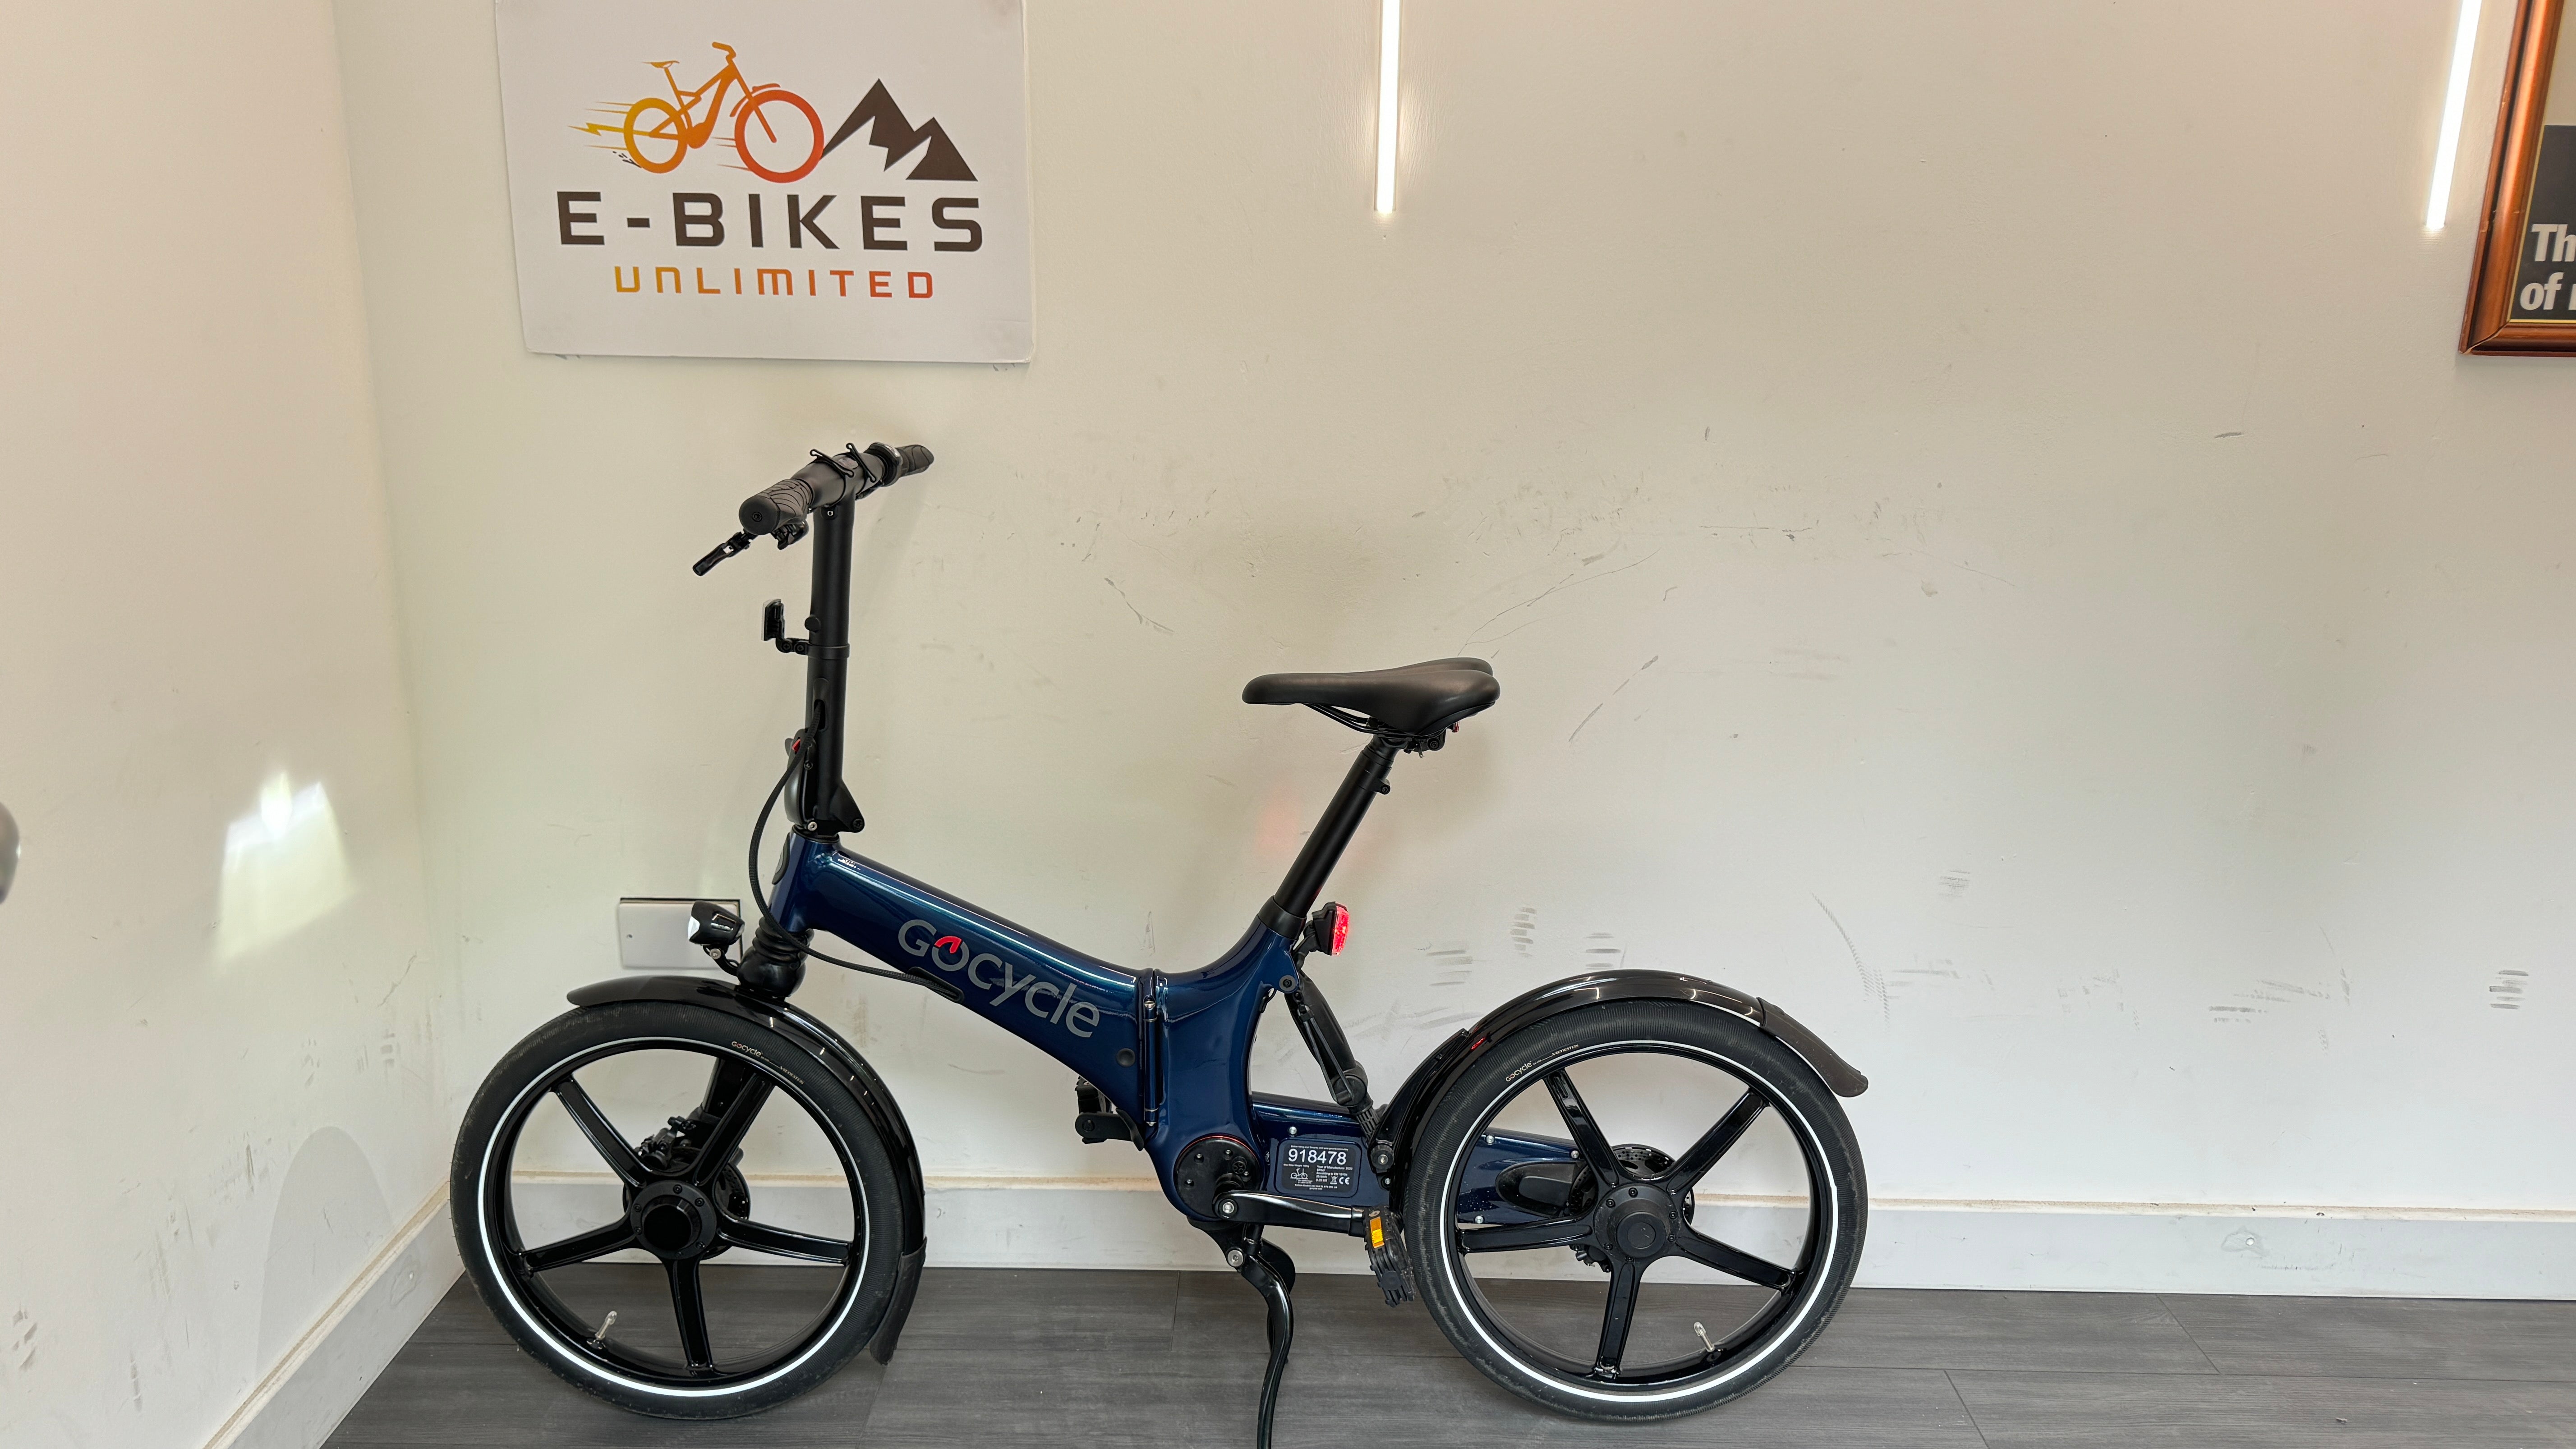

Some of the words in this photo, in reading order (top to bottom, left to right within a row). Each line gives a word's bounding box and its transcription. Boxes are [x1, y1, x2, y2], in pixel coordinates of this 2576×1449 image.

[557, 191, 982, 252] E-BIKES
[614, 266, 933, 299] UNLIMITED
[2520, 272, 2564, 311] of
[1288, 1148, 1346, 1165] 918478
